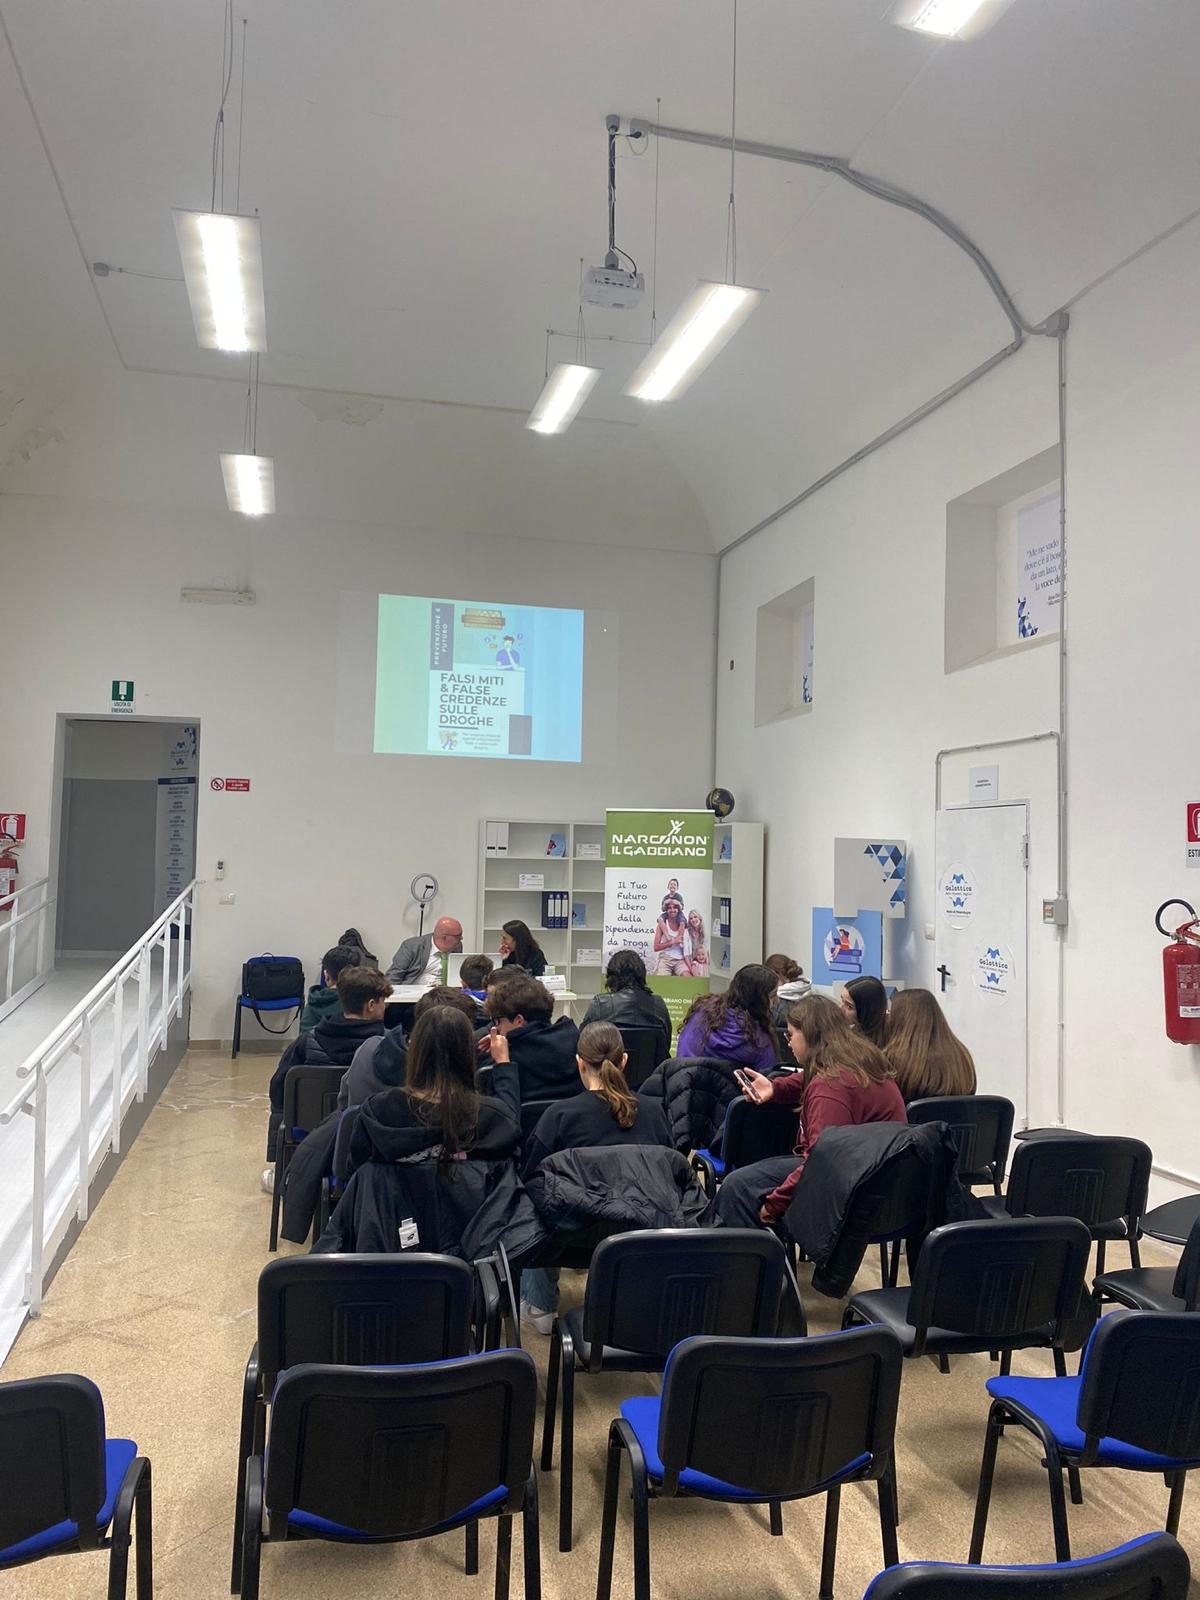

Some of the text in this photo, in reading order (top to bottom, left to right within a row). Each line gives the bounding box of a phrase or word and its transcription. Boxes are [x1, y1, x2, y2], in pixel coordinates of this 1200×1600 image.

[440, 672, 504, 686] FALSI MITI
[440, 683, 491, 695] & FALSE
[440, 693, 507, 707] CREDENZE
[439, 703, 478, 716] SULLE
[439, 714, 494, 727] DROGHE
[611, 834, 707, 846] NARCONON
[611, 846, 622, 856] IL
[623, 846, 707, 857] GABBIANO
[617, 881, 648, 890] Il Tuo
[617, 892, 648, 901] Futuro
[617, 902, 646, 911] Libero
[617, 914, 642, 923] dalla
[605, 925, 656, 937] Dipendenza
[607, 937, 649, 949] da Droga
